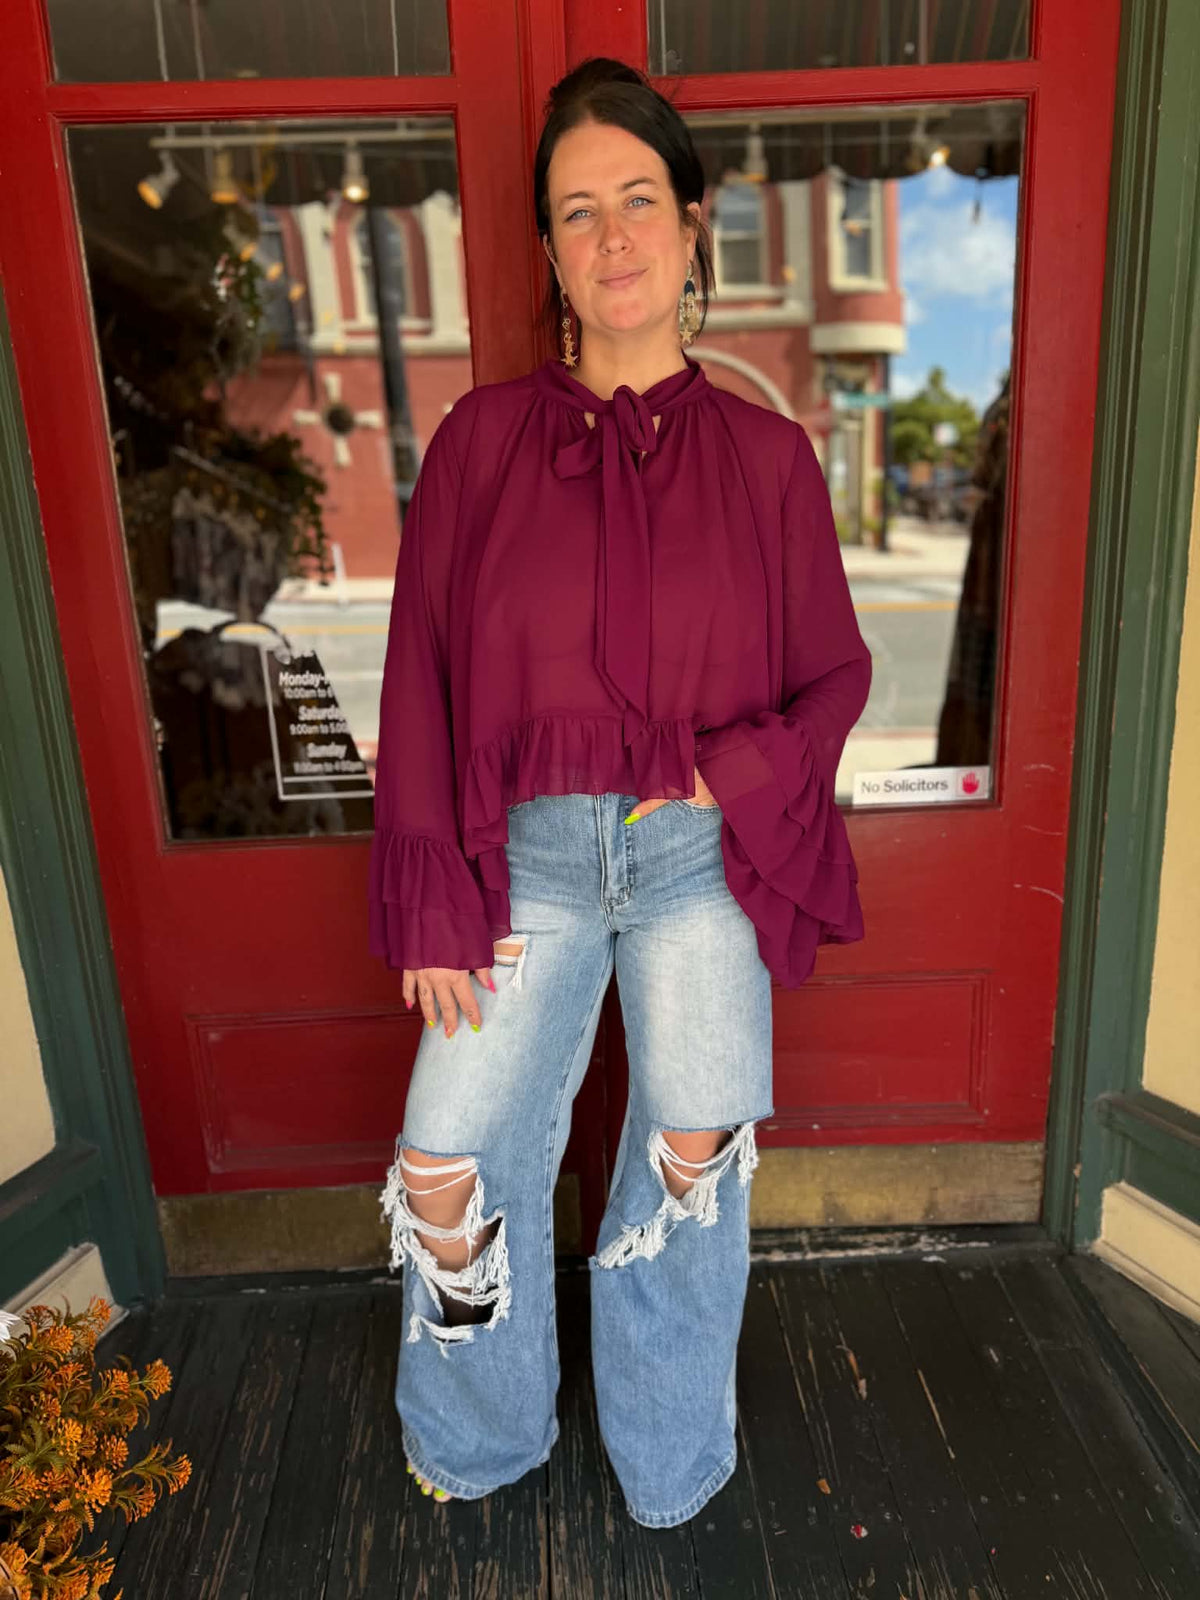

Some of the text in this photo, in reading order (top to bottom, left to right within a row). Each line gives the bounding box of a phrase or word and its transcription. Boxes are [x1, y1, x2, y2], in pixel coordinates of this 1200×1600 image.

[307, 742, 347, 759] Sunday
[861, 779, 949, 793] No Solicitors
